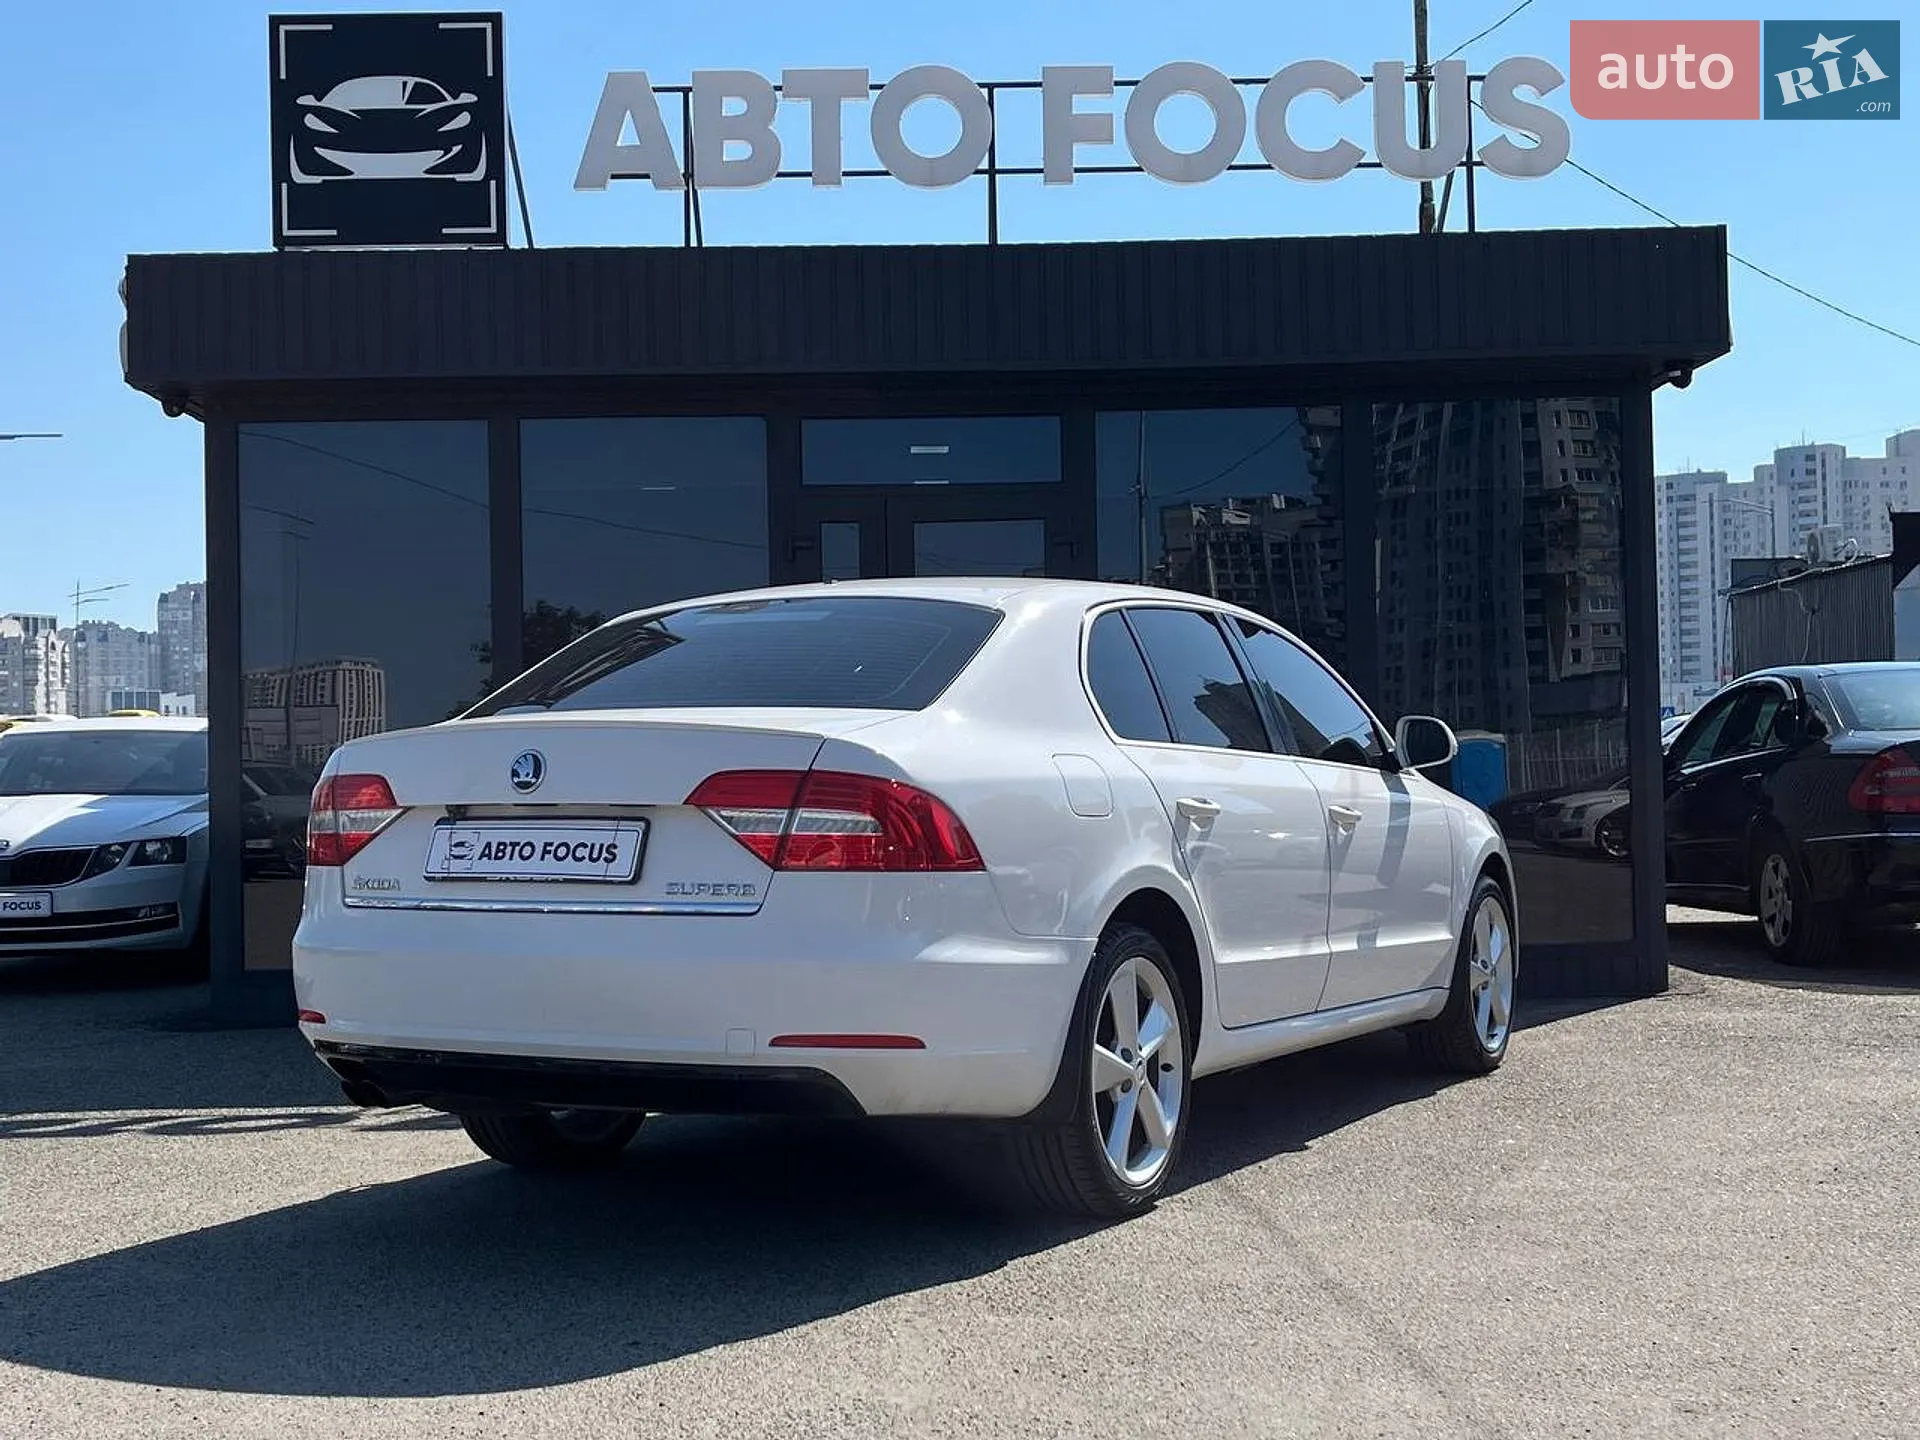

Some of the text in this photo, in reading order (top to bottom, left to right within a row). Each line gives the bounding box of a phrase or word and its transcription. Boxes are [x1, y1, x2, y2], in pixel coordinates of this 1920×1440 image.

[1041, 55, 1571, 187] FOCUS
[540, 841, 618, 863] FOCUS
[665, 882, 756, 897] SUPERB
[3, 901, 42, 911] FOCUS
